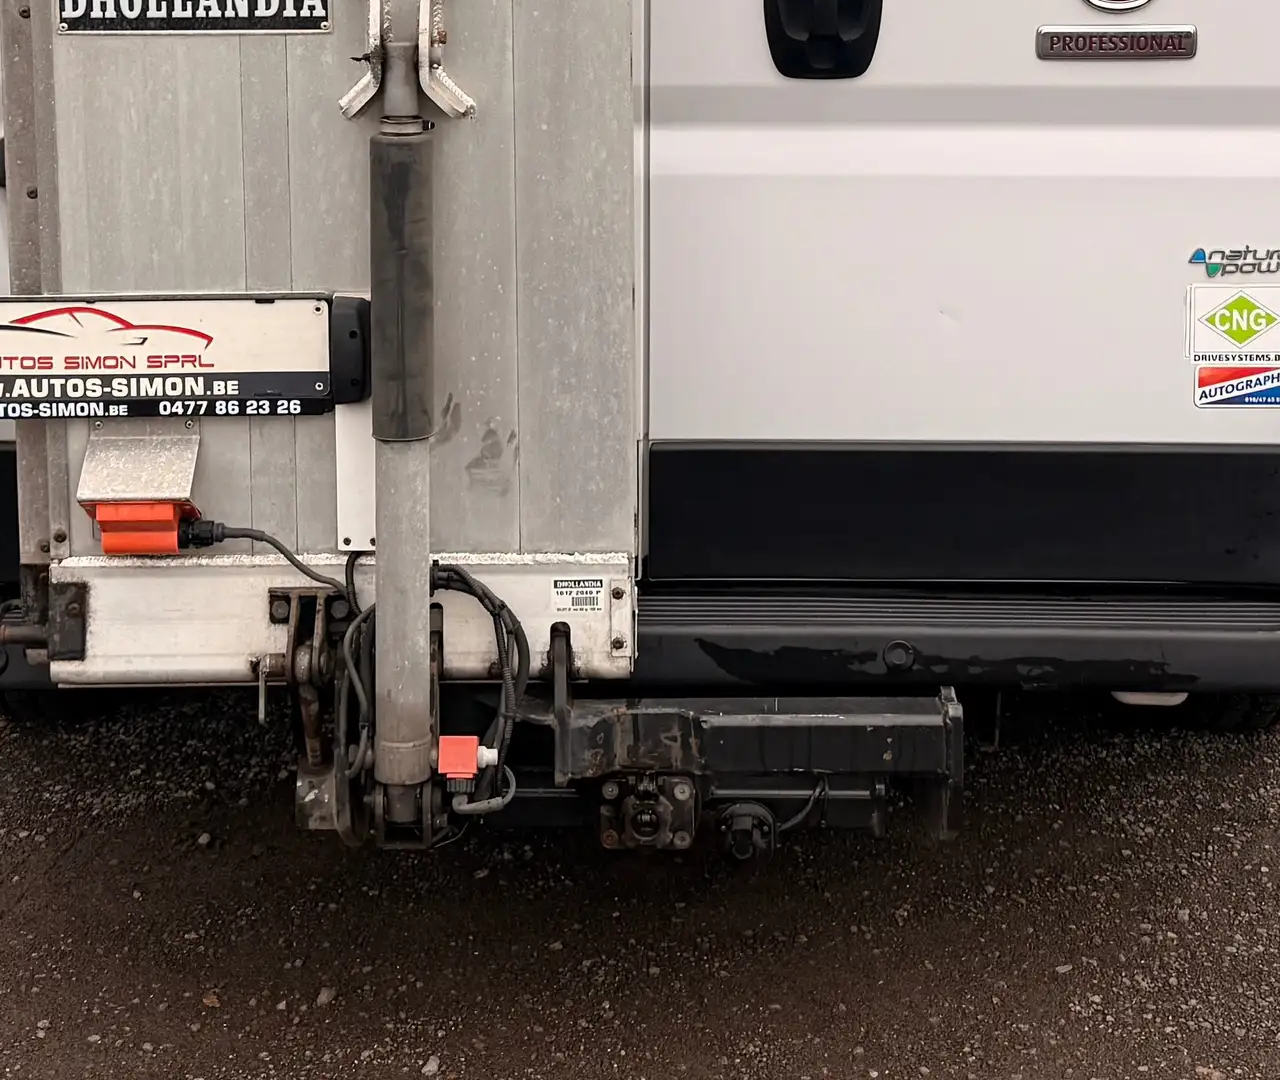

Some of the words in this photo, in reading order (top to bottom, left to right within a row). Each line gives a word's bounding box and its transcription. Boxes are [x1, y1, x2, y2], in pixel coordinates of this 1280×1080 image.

[1049, 34, 1187, 53] PROFESSIONAL
[1214, 308, 1268, 332] CNG
[64, 355, 136, 370] SIMON
[146, 354, 215, 369] SPRL
[158, 400, 209, 416] 0477
[215, 400, 239, 415] 86
[246, 400, 271, 415] 23
[276, 399, 302, 415] 26
